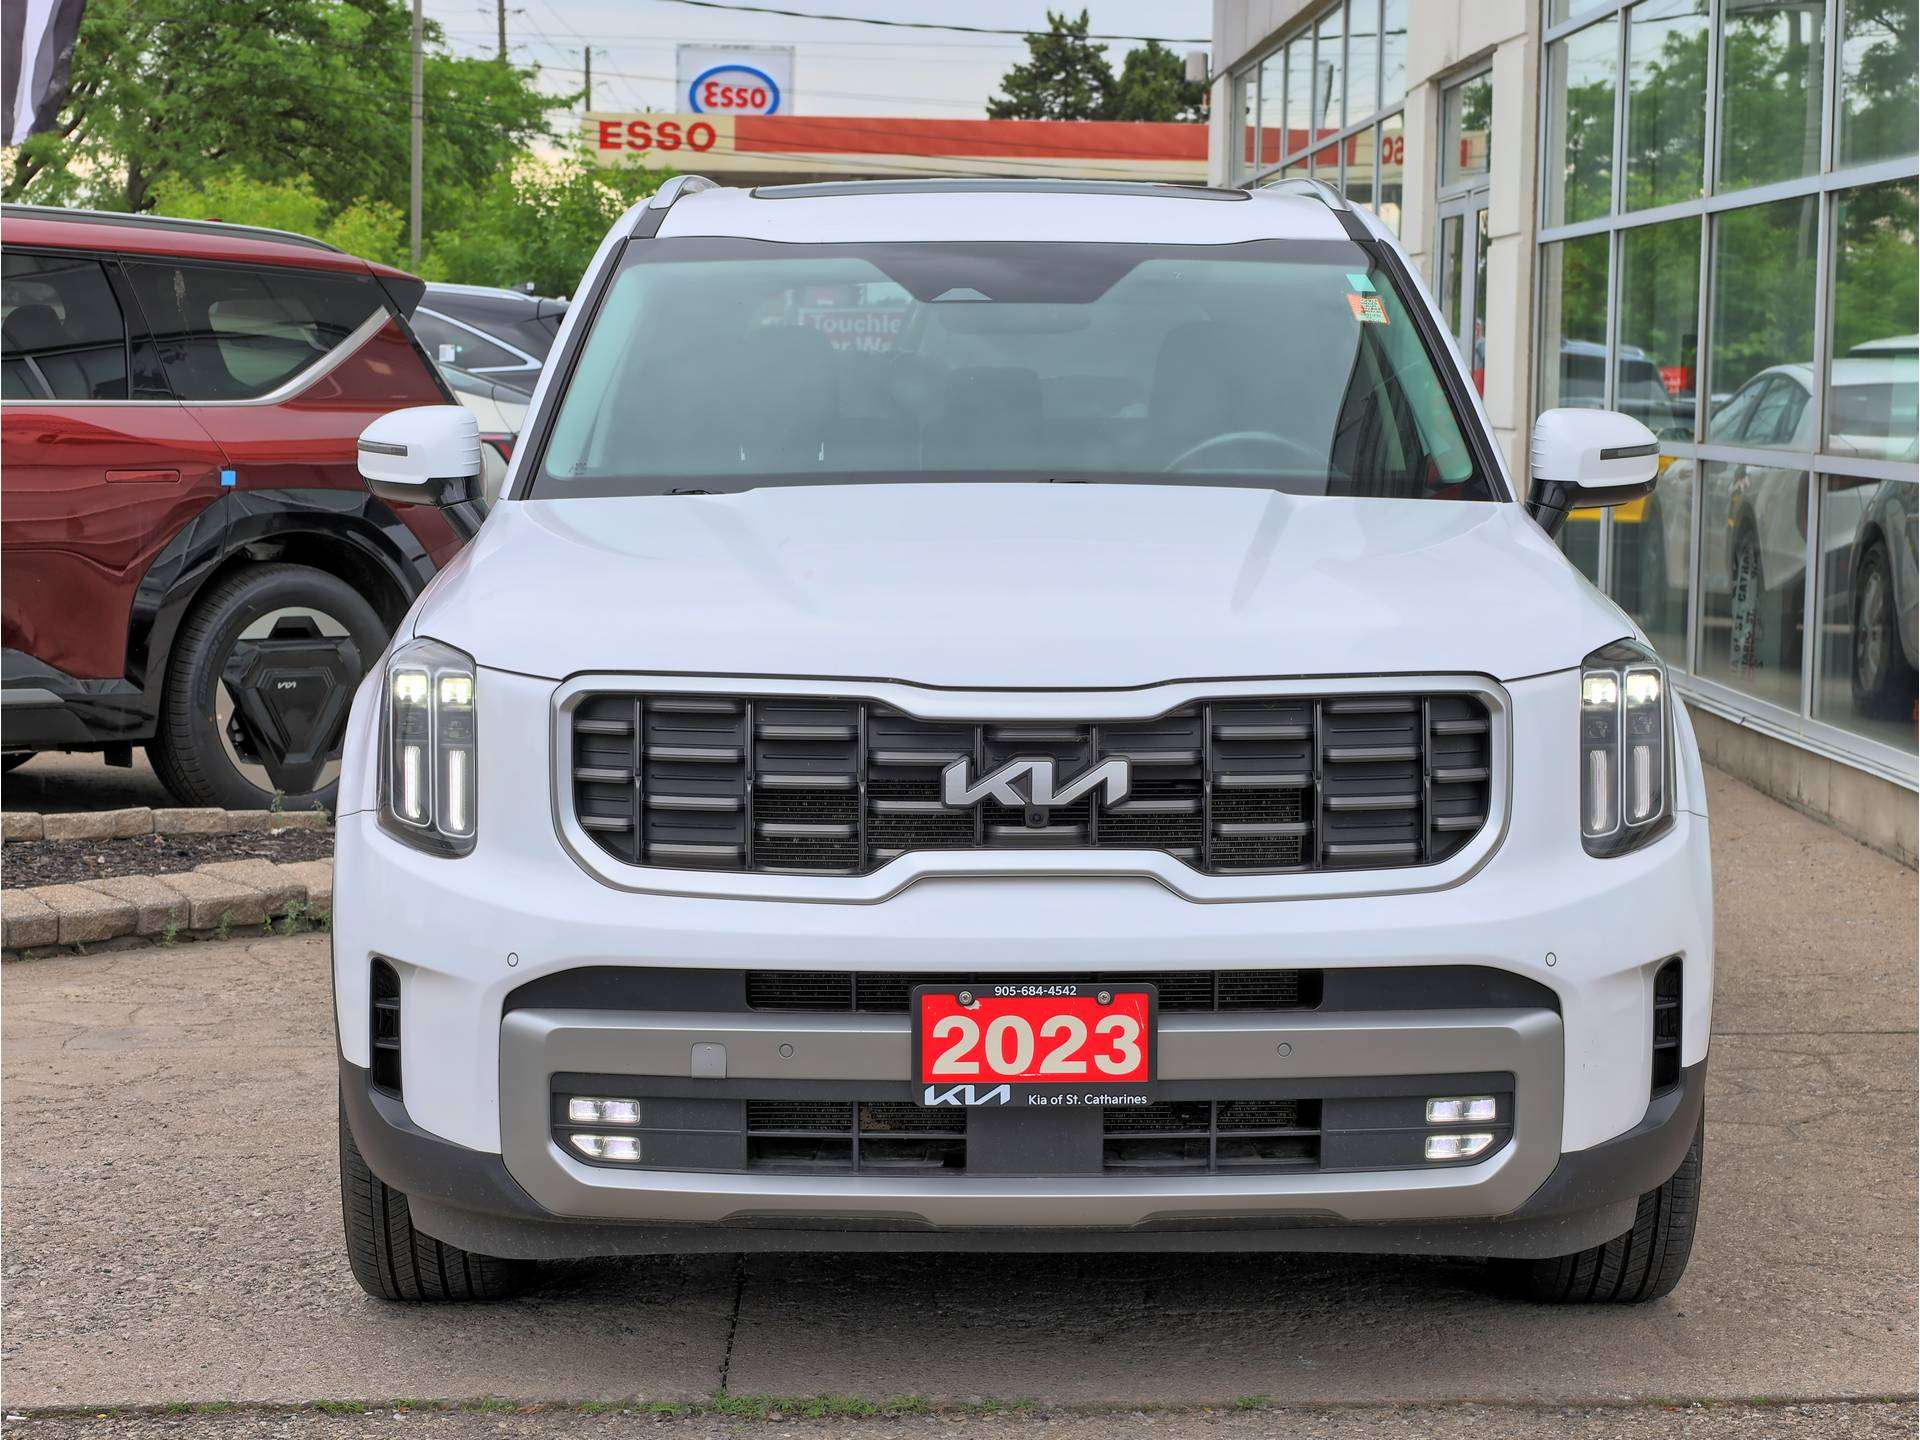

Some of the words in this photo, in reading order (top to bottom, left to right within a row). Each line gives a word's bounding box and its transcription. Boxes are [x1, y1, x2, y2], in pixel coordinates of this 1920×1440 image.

[703, 82, 766, 109] Esso
[599, 120, 716, 152] ESSO
[943, 757, 1130, 808] KIA
[994, 985, 1077, 997] 905-684-4542
[931, 1014, 1142, 1076] 2023
[924, 1084, 1011, 1106] KIA
[1028, 1094, 1047, 1105] Kia
[1050, 1094, 1063, 1105] of
[1066, 1094, 1081, 1105] St.
[1084, 1094, 1148, 1105] Catharines
